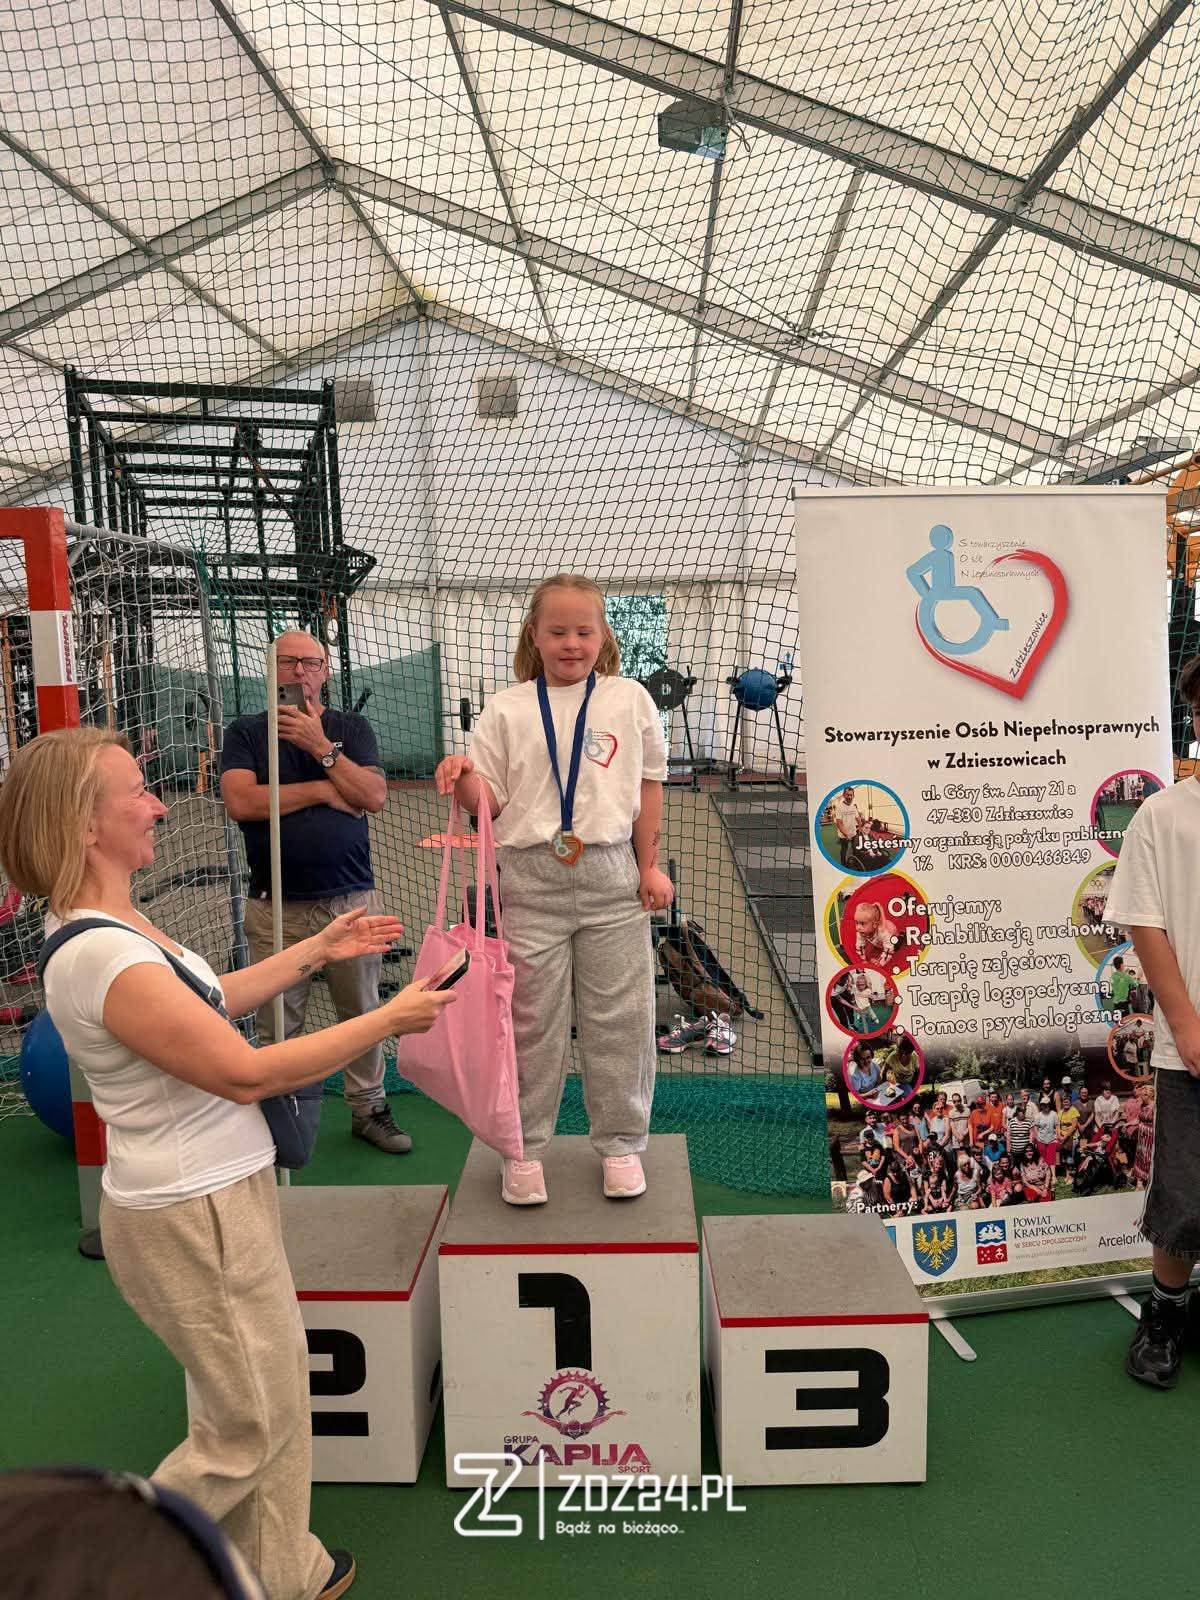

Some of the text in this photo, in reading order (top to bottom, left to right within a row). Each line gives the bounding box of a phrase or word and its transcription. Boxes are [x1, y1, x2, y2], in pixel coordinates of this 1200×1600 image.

[1009, 611, 1048, 679] Zdzieszowice
[824, 716, 1161, 747] Stowarzyszenie Osób Niepełnosprawnych
[927, 749, 1067, 769] w Zdzieszowicach
[922, 781, 1076, 804] ul. Góry św. Anny 21 a
[927, 805, 1073, 824] 47-330 Zdzieszowice
[855, 835, 921, 853] Jesteśmy
[923, 831, 1003, 851] organizacją
[1005, 828, 1060, 849] pożytku
[913, 849, 1092, 871] 1% KRS: 0000466849
[888, 895, 1002, 923] Oferujemy:
[905, 917, 1117, 948] Rehabilitacją ruchową
[906, 949, 1072, 982] Terapię zajęciową
[907, 977, 1112, 1011] Terapię logopedyczną
[910, 1005, 1123, 1039] Pomoc psychologiczną
[857, 1201, 918, 1214] Partnerzy:
[1013, 1216, 1051, 1227] POWIAT
[1014, 1222, 1087, 1239] KRAPKOWICKI
[1098, 1231, 1149, 1248] ArcelorM
[518, 1273, 592, 1370] 1
[306, 1329, 370, 1437] 2
[765, 1347, 890, 1450] 3
[503, 1435, 540, 1444] GRUPA
[618, 1465, 651, 1473] SPORT
